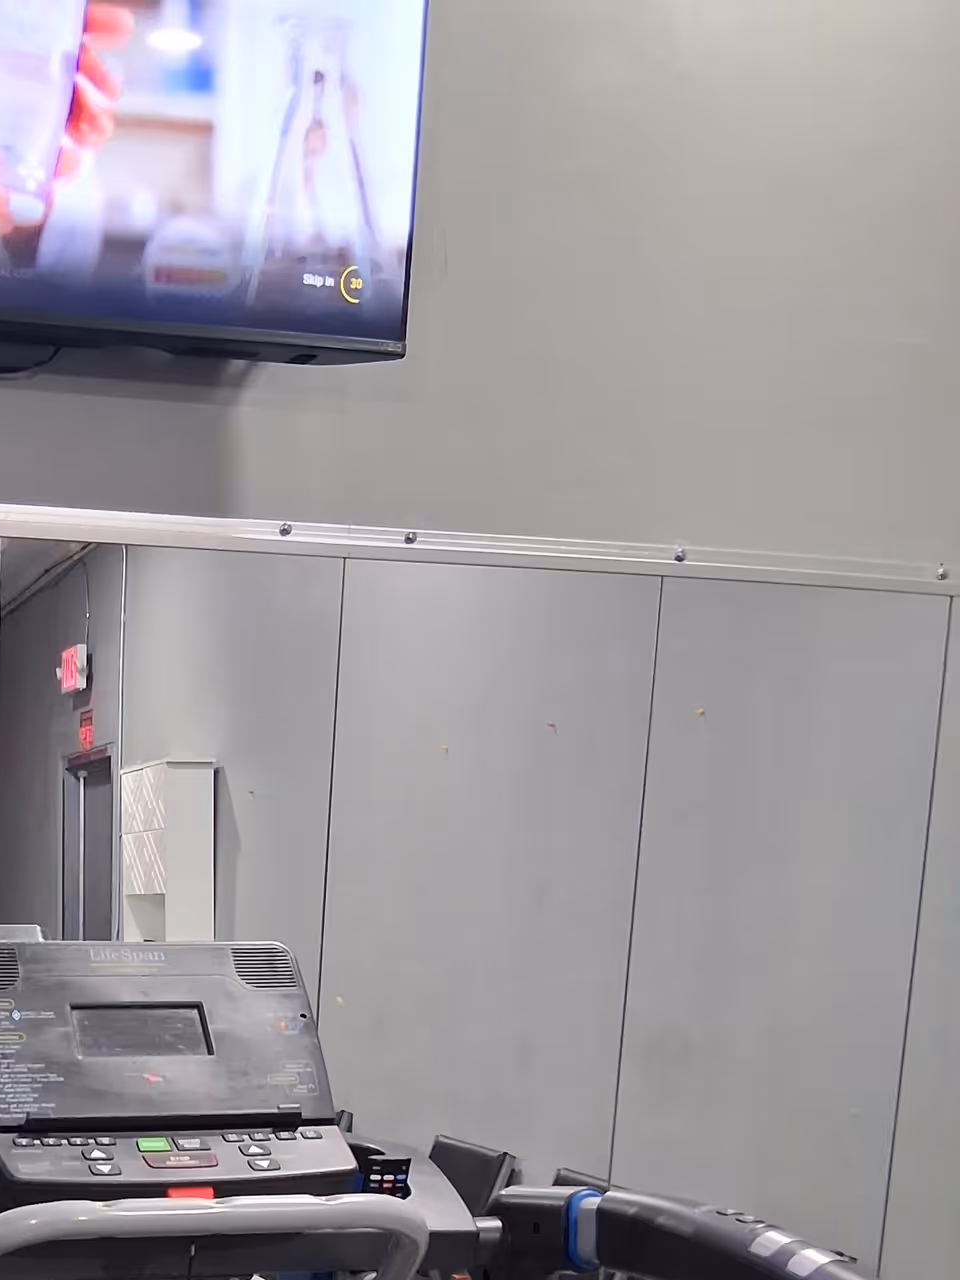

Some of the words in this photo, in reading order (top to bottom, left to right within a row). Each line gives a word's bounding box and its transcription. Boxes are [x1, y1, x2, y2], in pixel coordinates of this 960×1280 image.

[302, 273, 324, 288] Skip
[325, 275, 335, 287] in
[88, 947, 167, 962] LifeSpan
